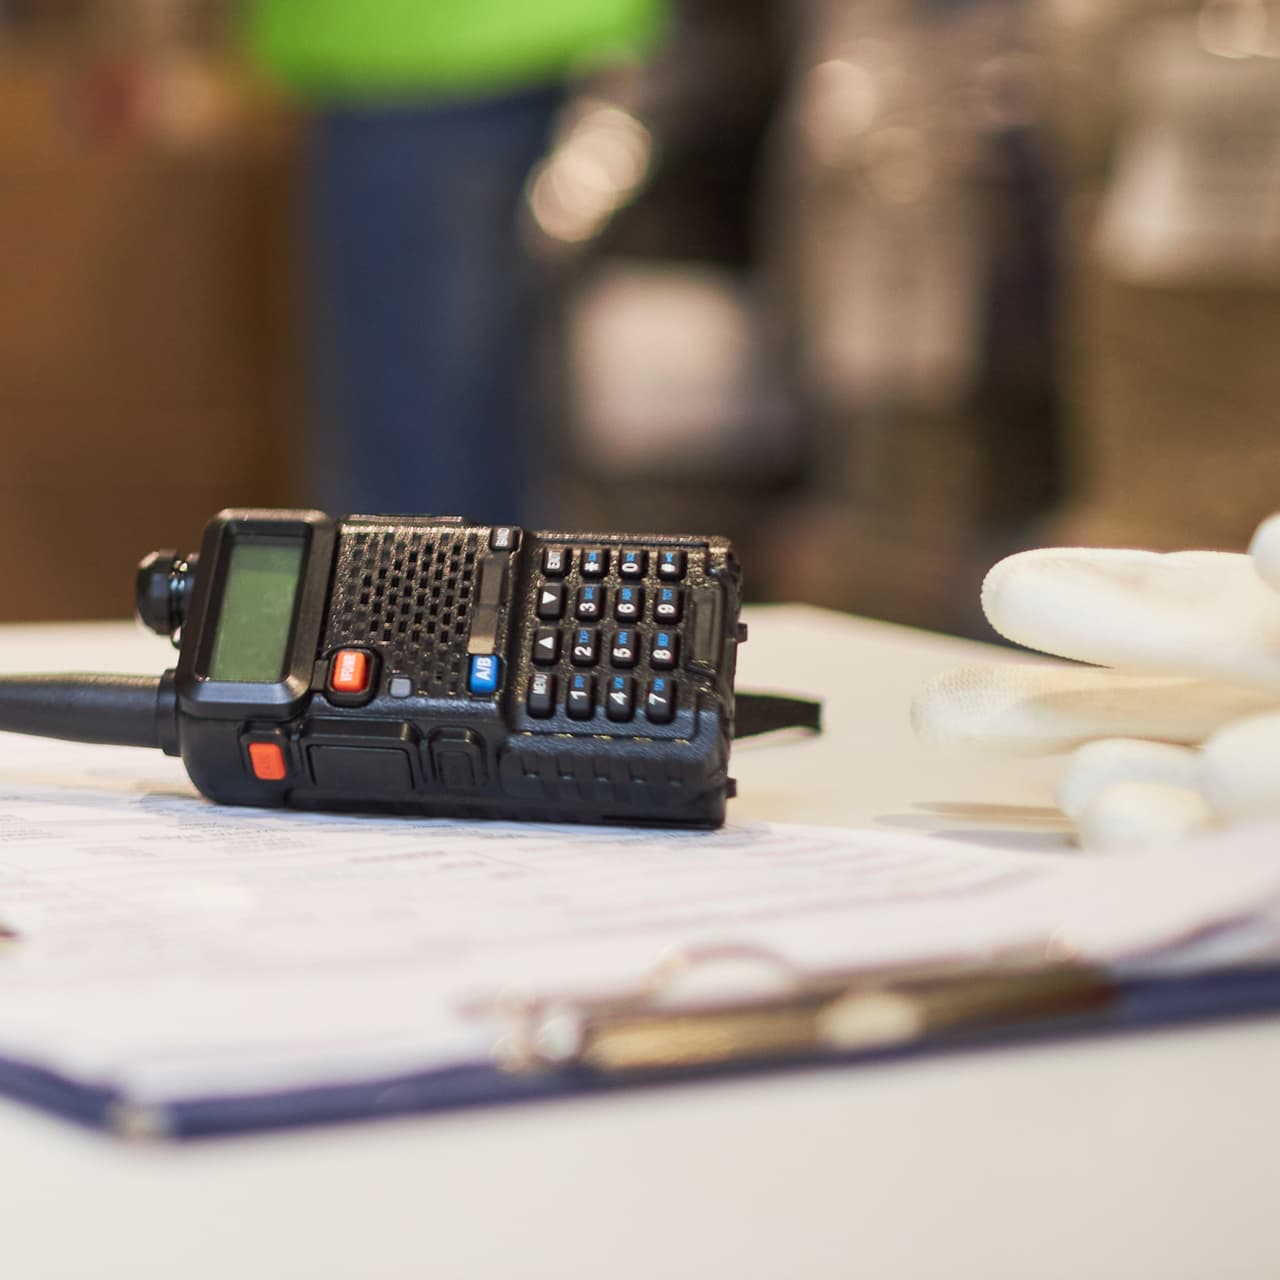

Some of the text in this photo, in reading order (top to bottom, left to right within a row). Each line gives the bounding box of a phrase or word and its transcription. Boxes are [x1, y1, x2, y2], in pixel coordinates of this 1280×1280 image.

[621, 562, 639, 573] 0
[578, 602, 597, 612] 3
[617, 602, 635, 613] 6
[657, 603, 676, 614] 9
[573, 646, 592, 657] 2
[612, 647, 632, 658] 5
[652, 649, 672, 660] 8
[476, 657, 493, 681] A/B
[532, 674, 548, 695] MENU
[569, 690, 588, 701] 1
[609, 691, 628, 706] 4
[648, 692, 668, 706] 7
